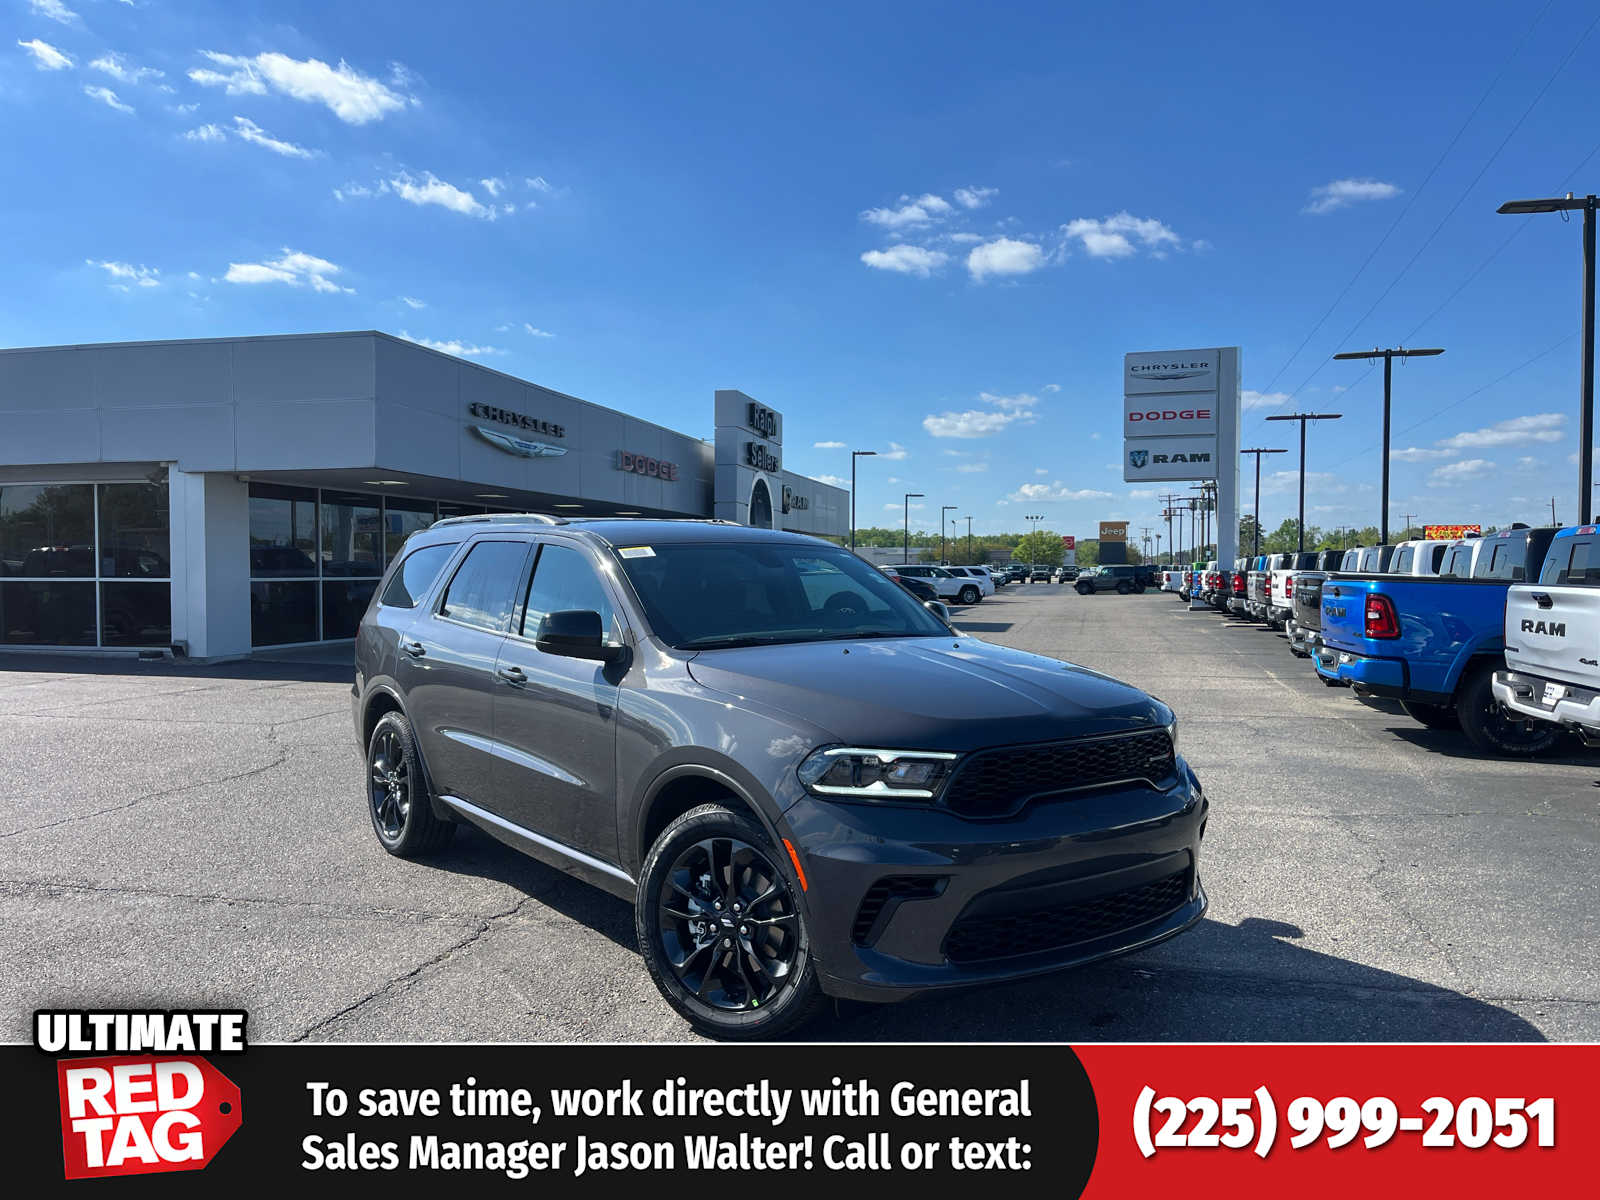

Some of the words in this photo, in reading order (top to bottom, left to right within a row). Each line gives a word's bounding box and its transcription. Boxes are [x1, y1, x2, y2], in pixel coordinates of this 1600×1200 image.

[1131, 362, 1209, 372] CHRYSLER
[469, 402, 565, 438] CHRYSLER
[749, 403, 776, 438] Ralph
[1129, 410, 1211, 422] DODGE
[747, 442, 778, 472] Sellers
[1153, 453, 1210, 464] RAM
[616, 450, 680, 481] DODGE
[1101, 527, 1125, 535] Jeep
[1325, 606, 1346, 617] RAM
[1521, 619, 1566, 637] RAM
